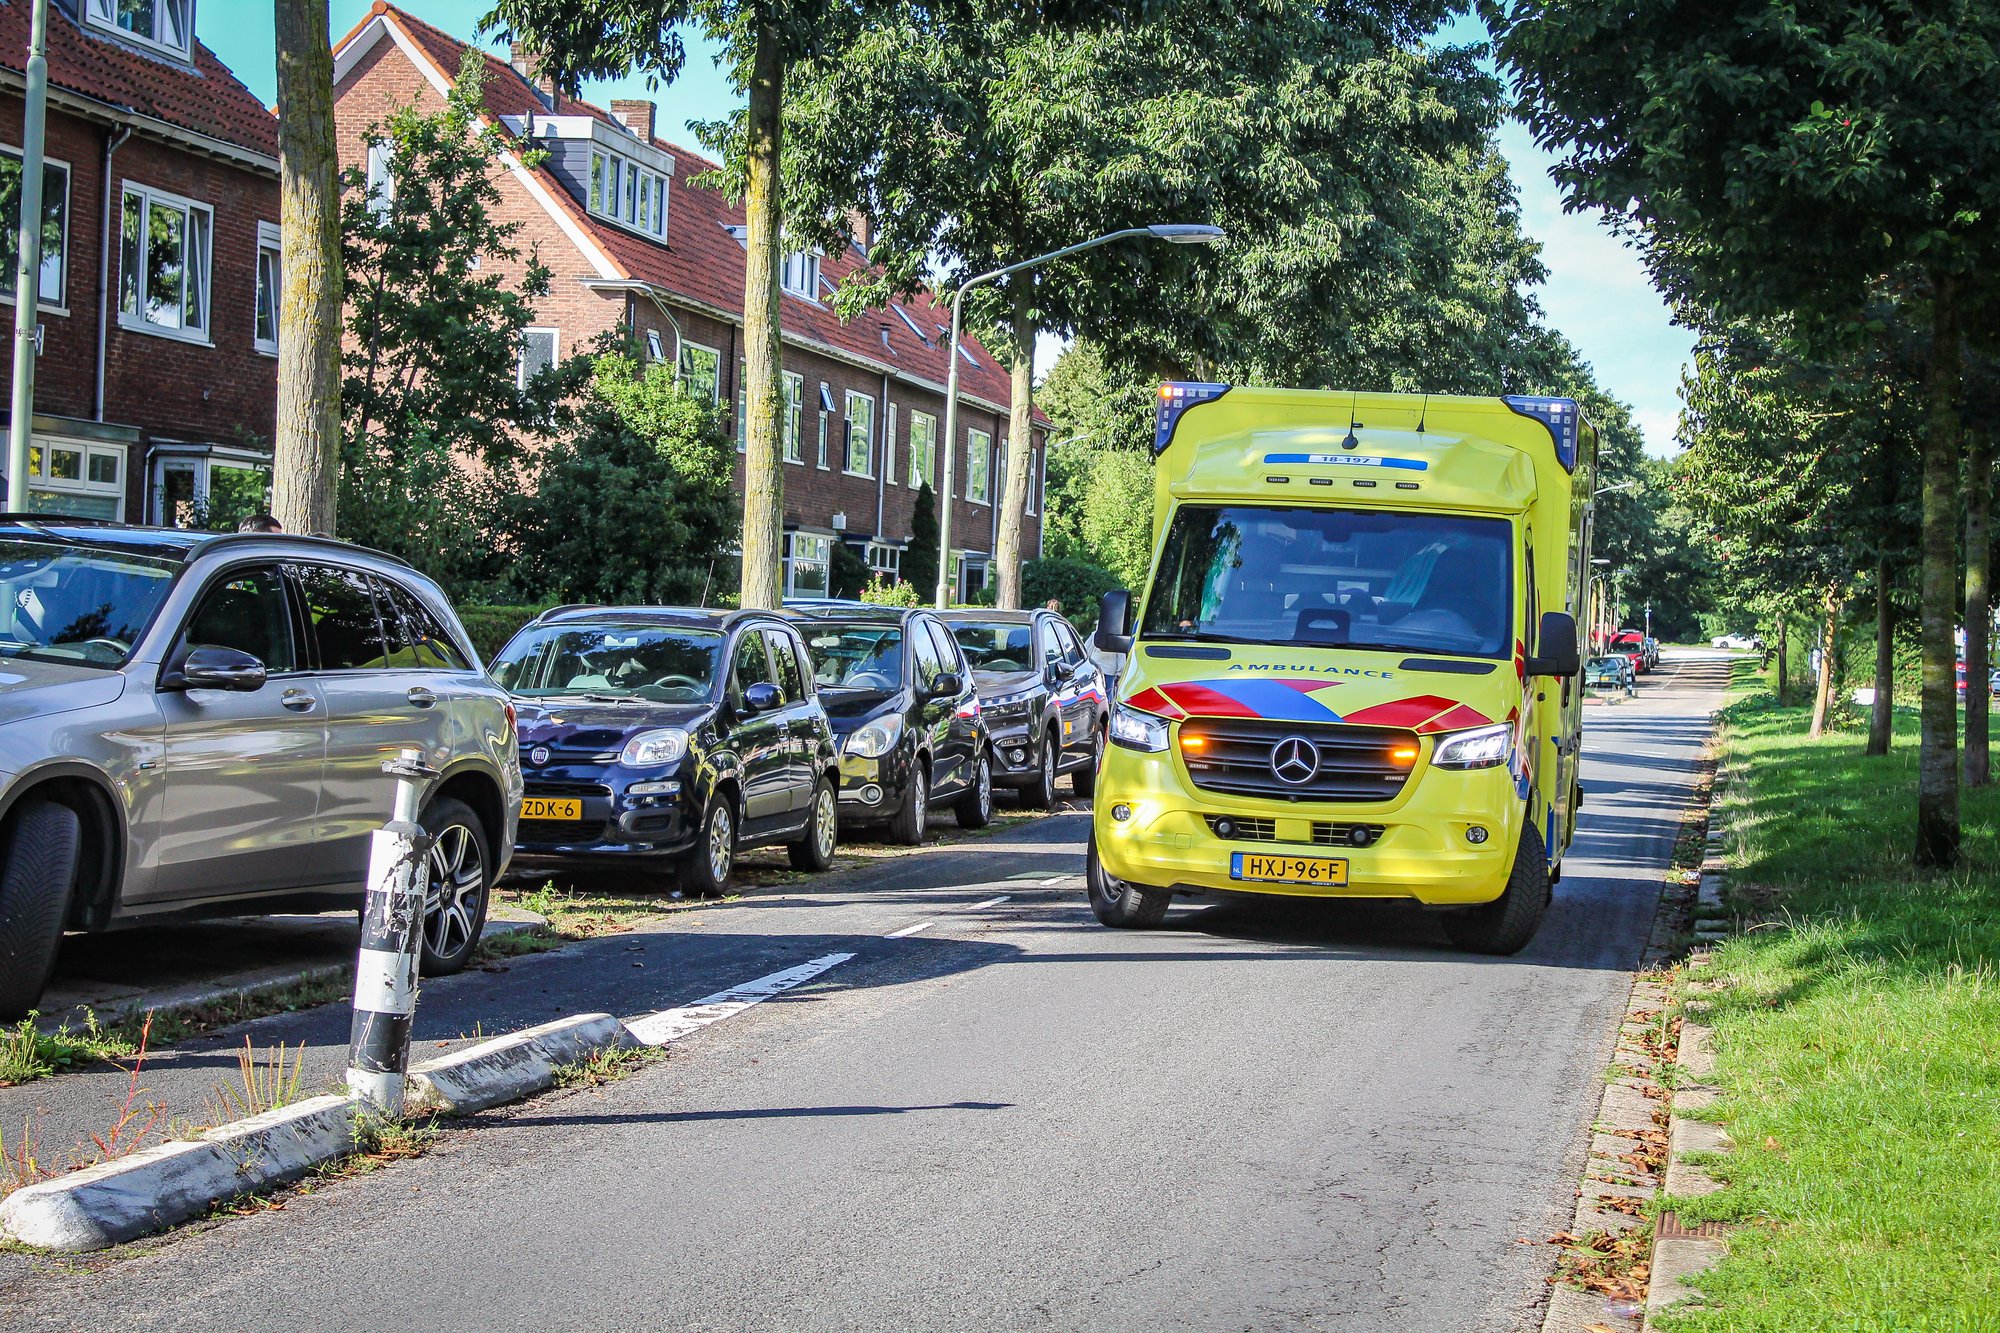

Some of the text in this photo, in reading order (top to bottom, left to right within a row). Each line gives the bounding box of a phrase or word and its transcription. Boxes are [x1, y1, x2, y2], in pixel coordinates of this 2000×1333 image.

[1321, 456, 1370, 464] 18-197
[1227, 664, 1394, 679] AMBULANCE
[1250, 858, 1339, 880] HXJ-96-F
